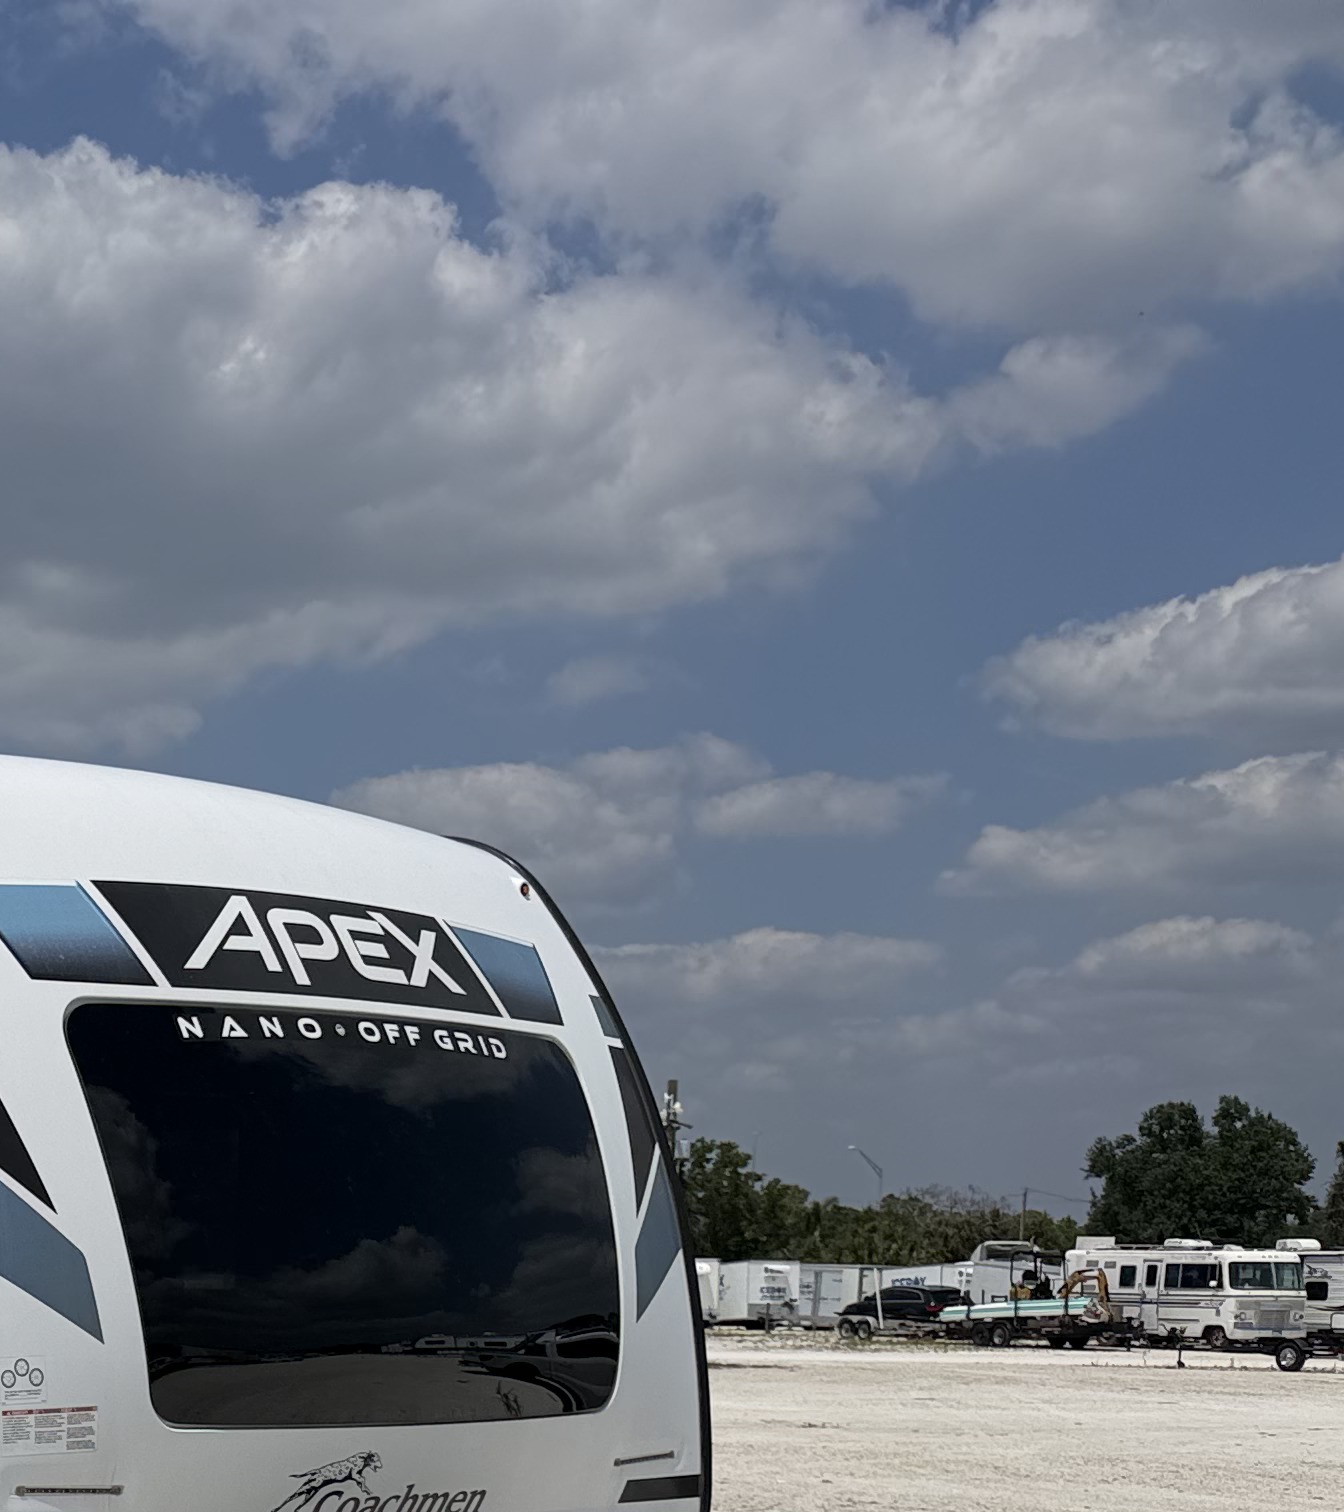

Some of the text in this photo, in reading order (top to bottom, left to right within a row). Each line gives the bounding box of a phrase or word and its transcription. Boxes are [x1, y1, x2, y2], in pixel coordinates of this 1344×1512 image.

[184, 896, 467, 996] APEX
[176, 1015, 507, 1060] NANO OFF GRID
